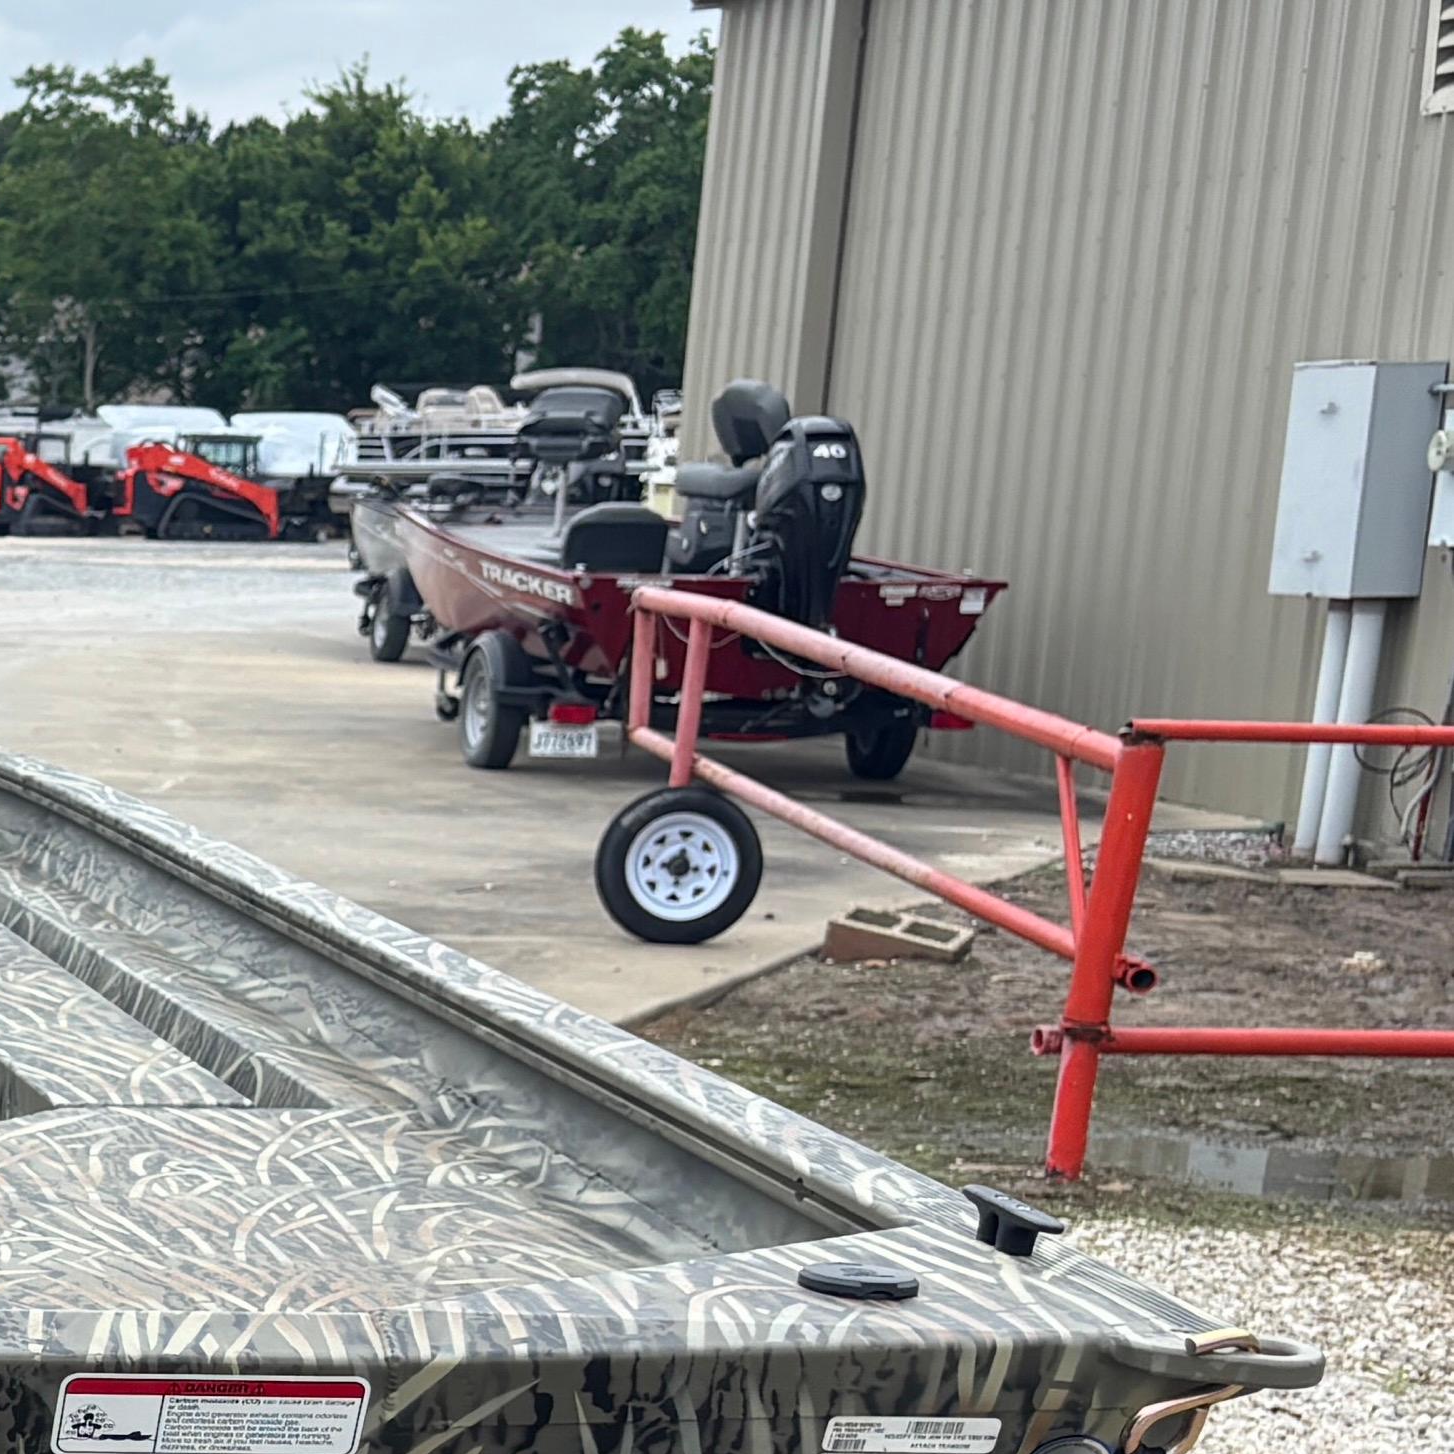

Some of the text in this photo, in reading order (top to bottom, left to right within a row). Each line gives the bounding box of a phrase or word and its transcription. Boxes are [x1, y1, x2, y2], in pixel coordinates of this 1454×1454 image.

[812, 444, 847, 459] 40
[479, 560, 574, 606] TRACKER
[184, 1382, 250, 1393] DANGER
